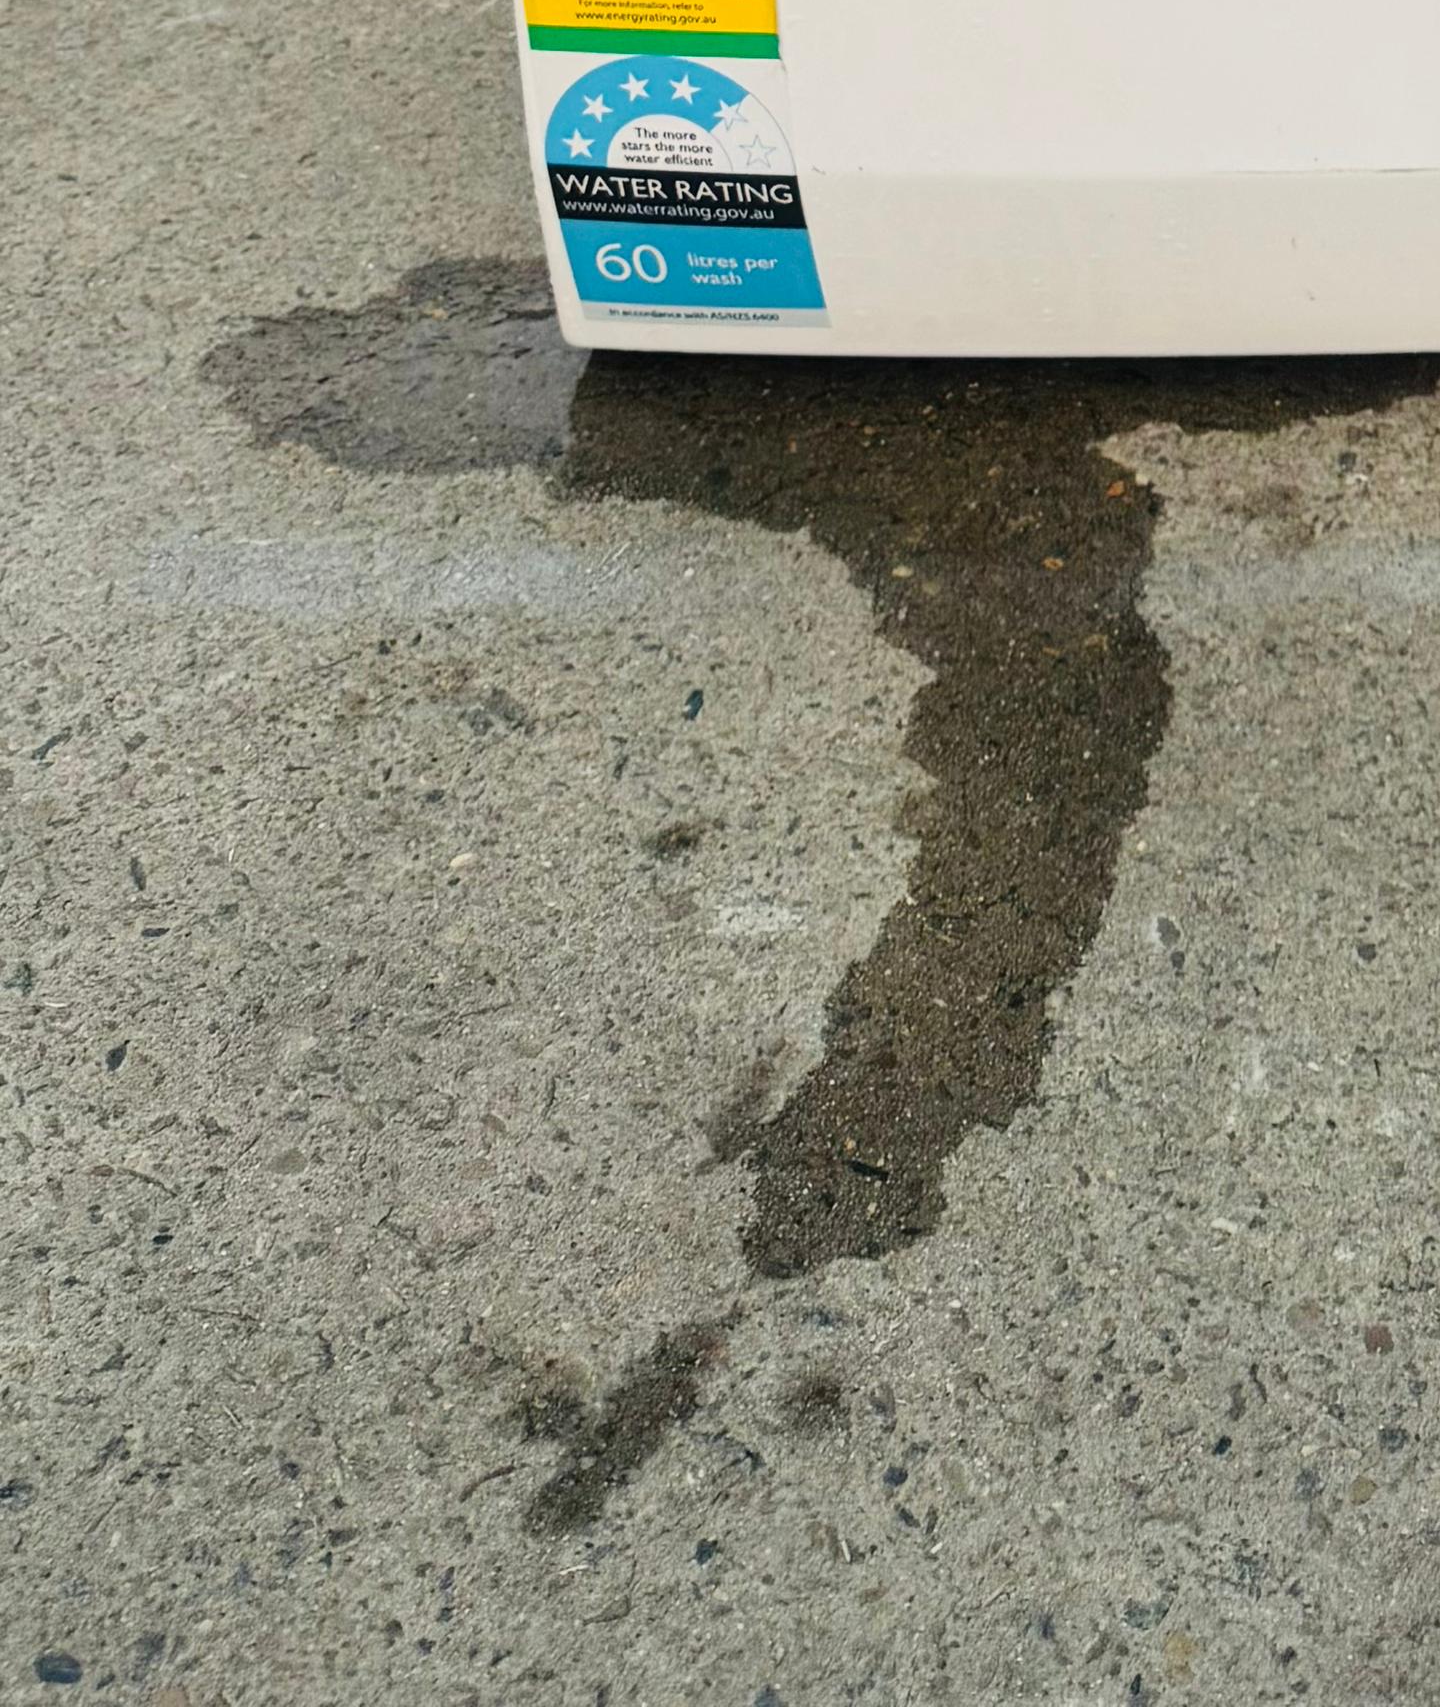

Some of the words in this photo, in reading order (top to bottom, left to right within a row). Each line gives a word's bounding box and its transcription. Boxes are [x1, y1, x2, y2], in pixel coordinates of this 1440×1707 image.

[694, 3, 704, 11] to
[576, 11, 716, 25] www.energyrating.gov.au
[634, 127, 659, 139] The
[663, 130, 696, 141] more
[622, 141, 650, 151] stars
[655, 141, 675, 152] the
[680, 143, 713, 154] more
[625, 154, 658, 164] water
[664, 154, 713, 166] efficient
[555, 173, 668, 200] WATER
[675, 179, 794, 204] RATING
[563, 199, 774, 220] www.waterrating.gov.au
[595, 243, 668, 284] 60
[687, 252, 738, 268] litres
[744, 257, 778, 272] per
[692, 271, 743, 286] wash
